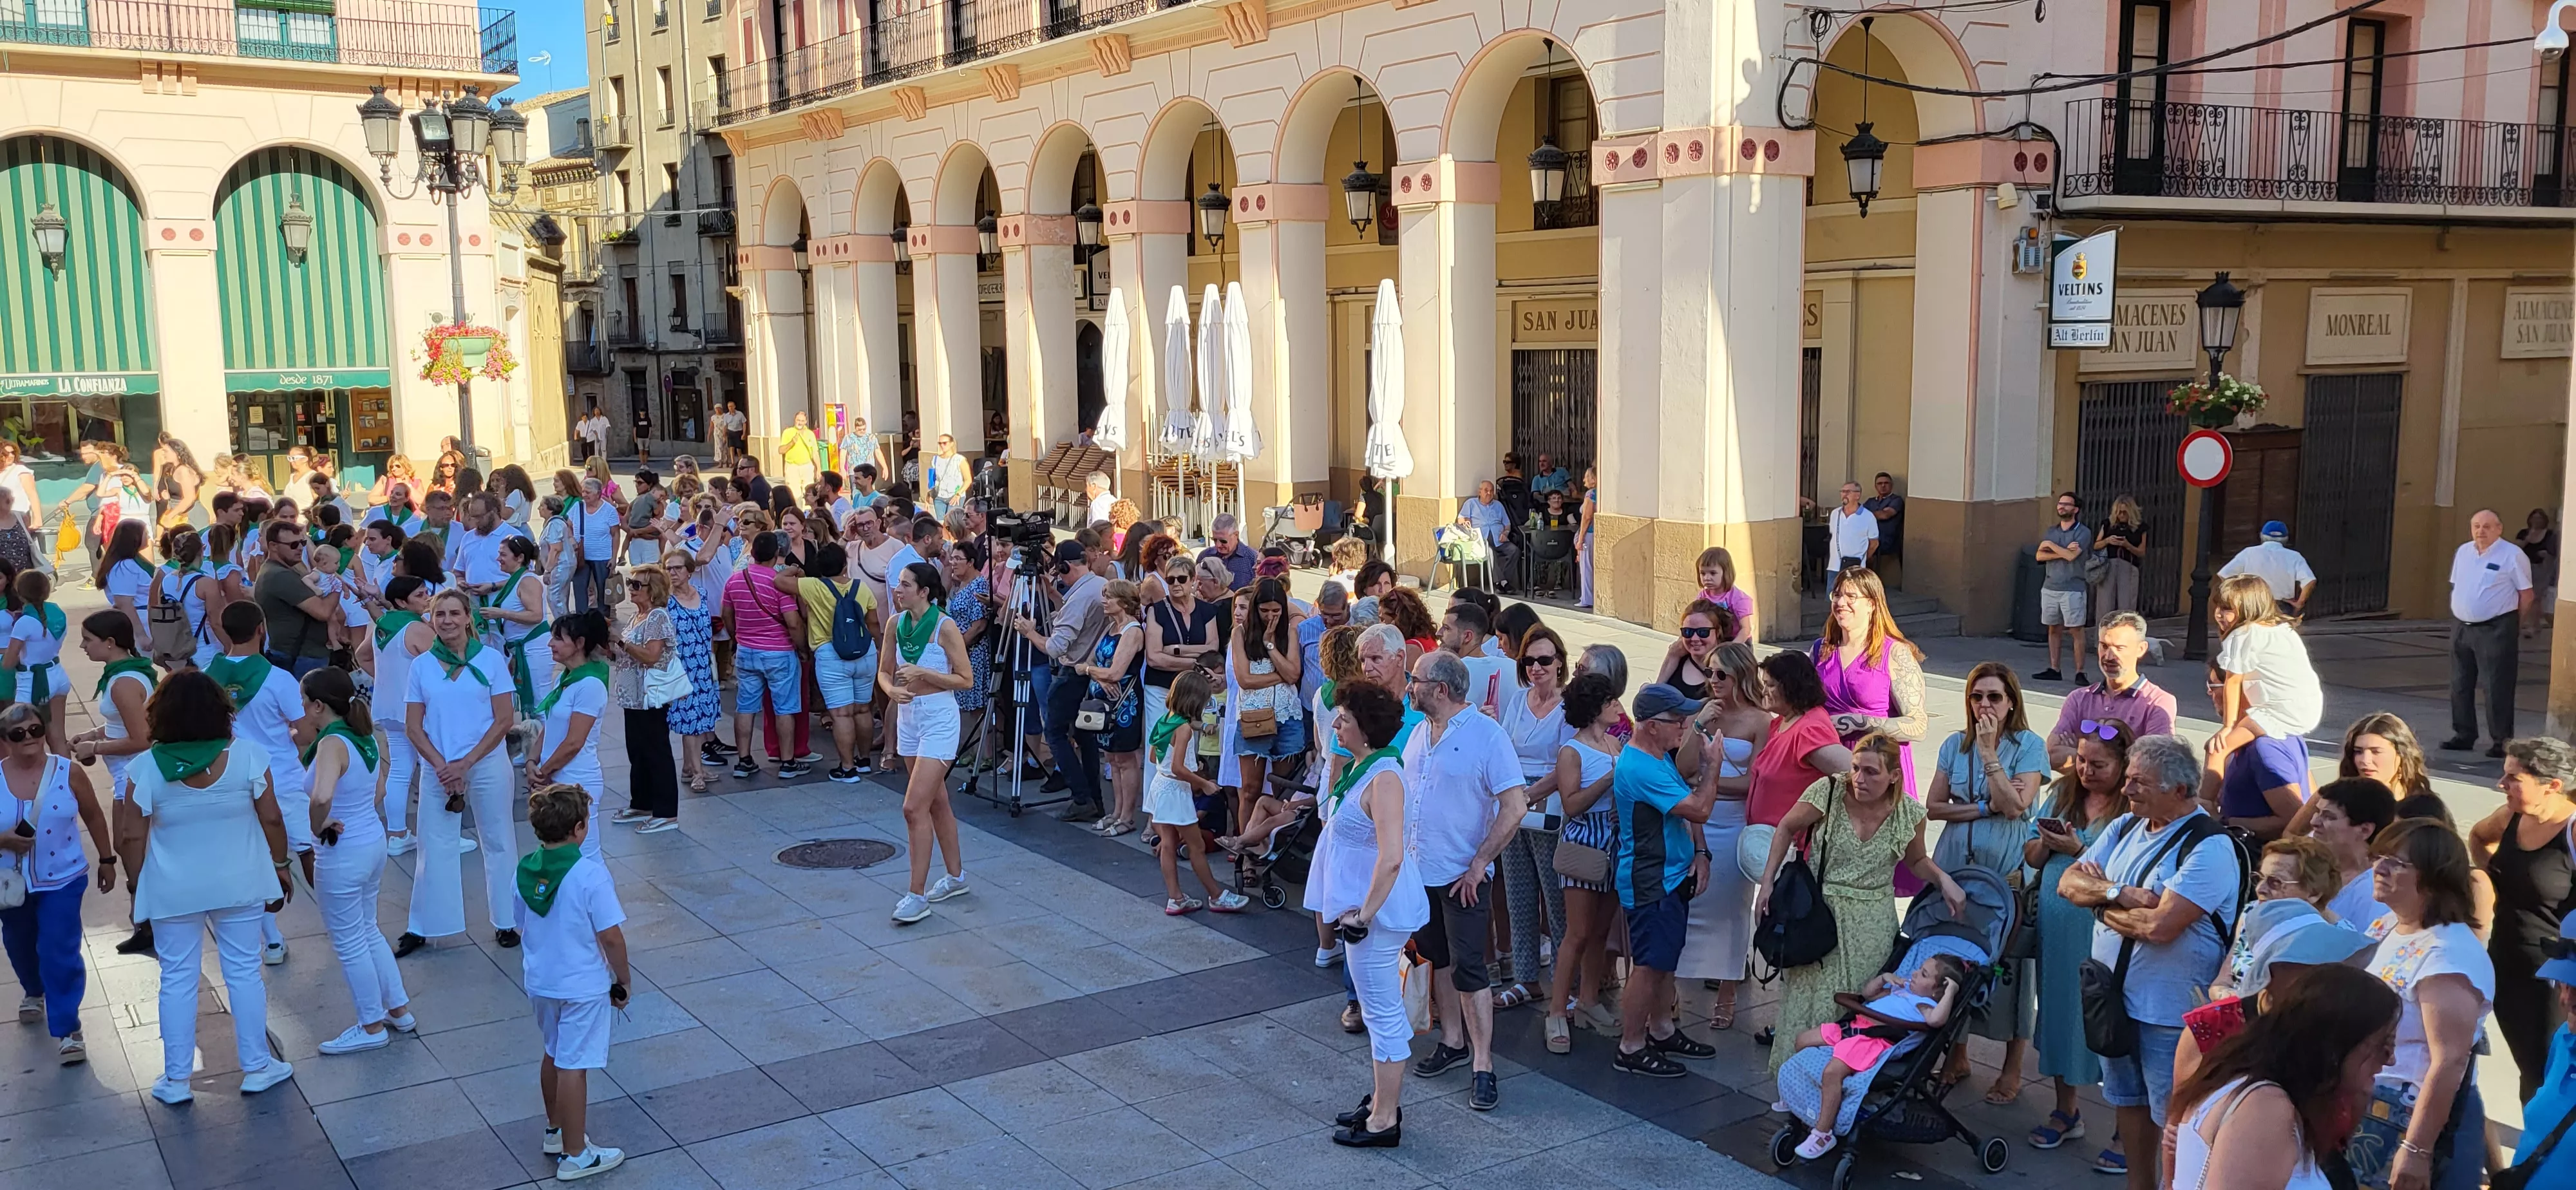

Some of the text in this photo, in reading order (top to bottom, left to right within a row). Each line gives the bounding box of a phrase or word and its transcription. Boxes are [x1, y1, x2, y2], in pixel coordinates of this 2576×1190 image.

[2058, 282, 2103, 296] VELTINS
[1523, 309, 1598, 331] SAN JUA
[2115, 303, 2186, 326] MACENES
[2513, 300, 2574, 320] ALMACENE
[2054, 328, 2105, 341] Alt Berlin
[2325, 314, 2391, 336] MONREAL
[2517, 323, 2539, 343] SAN
[2136, 330, 2178, 353] JUAN
[58, 377, 71, 393] LA
[74, 377, 128, 392] CONFIANZA
[279, 373, 334, 386] desde 1871
